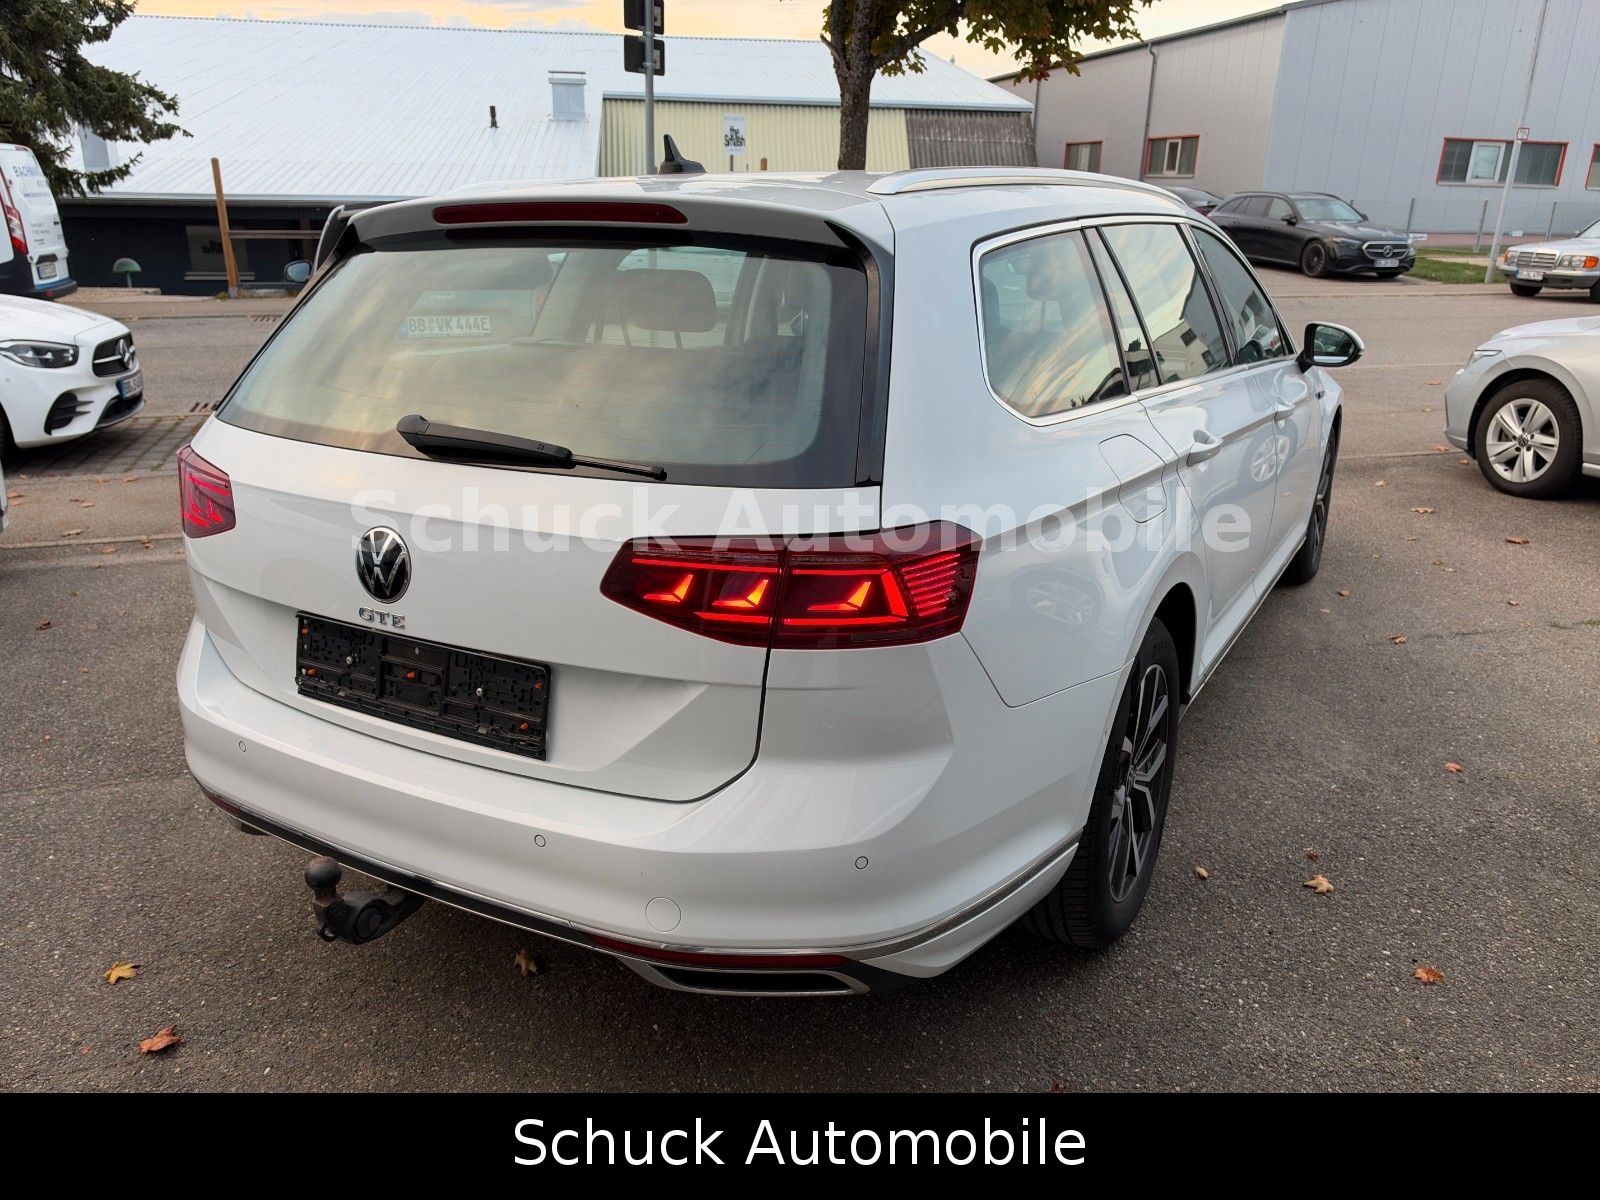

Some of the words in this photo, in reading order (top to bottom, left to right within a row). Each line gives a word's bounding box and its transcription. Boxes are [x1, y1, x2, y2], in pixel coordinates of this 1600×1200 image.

[408, 317, 426, 333] BB
[436, 317, 453, 332] VK
[358, 606, 406, 630] GTE
